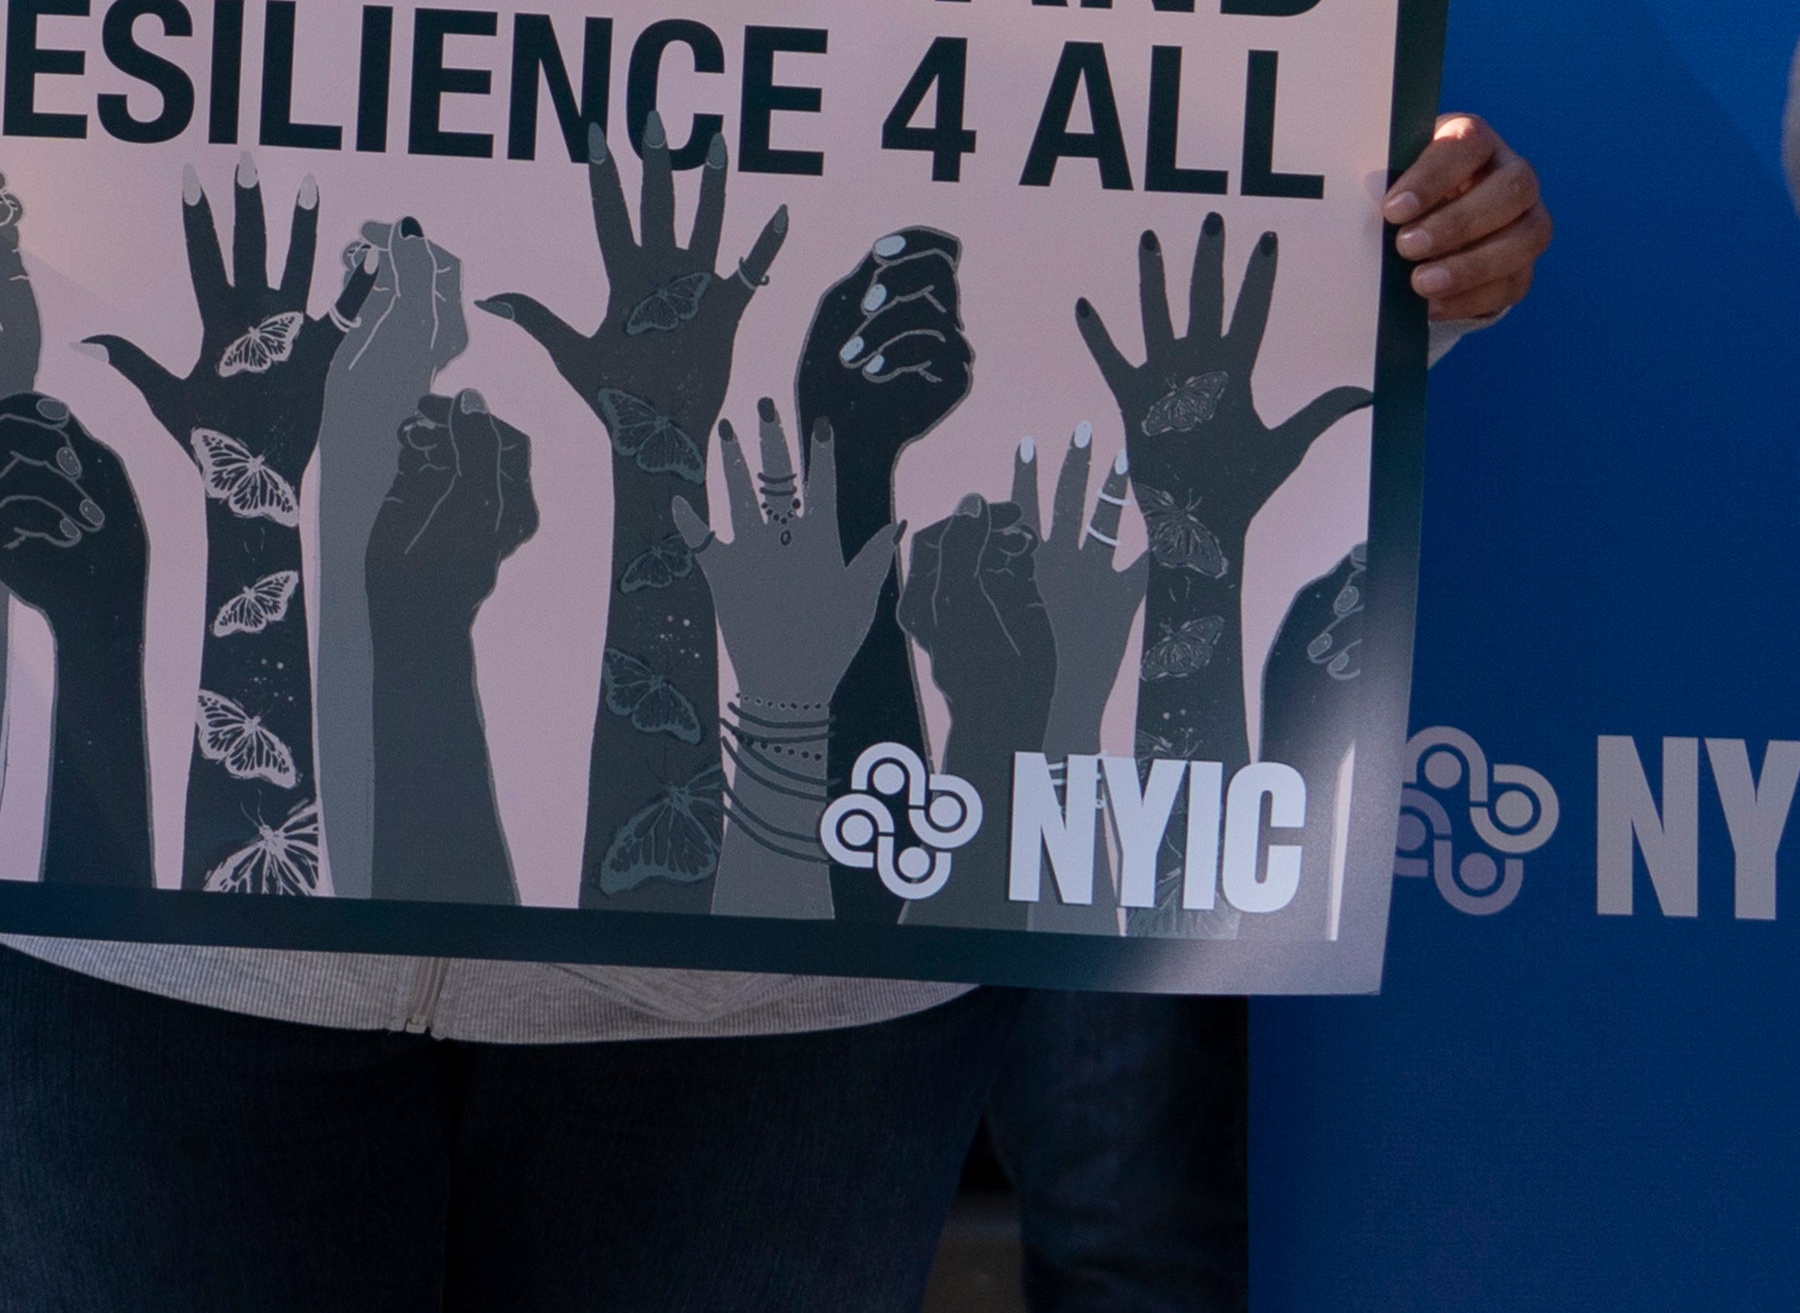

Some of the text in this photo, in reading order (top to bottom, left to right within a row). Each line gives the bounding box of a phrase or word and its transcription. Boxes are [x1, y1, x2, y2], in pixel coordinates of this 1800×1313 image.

[880, 33, 978, 183] 4
[1018, 38, 1327, 200] ALL
[1008, 751, 1307, 914] NYIC
